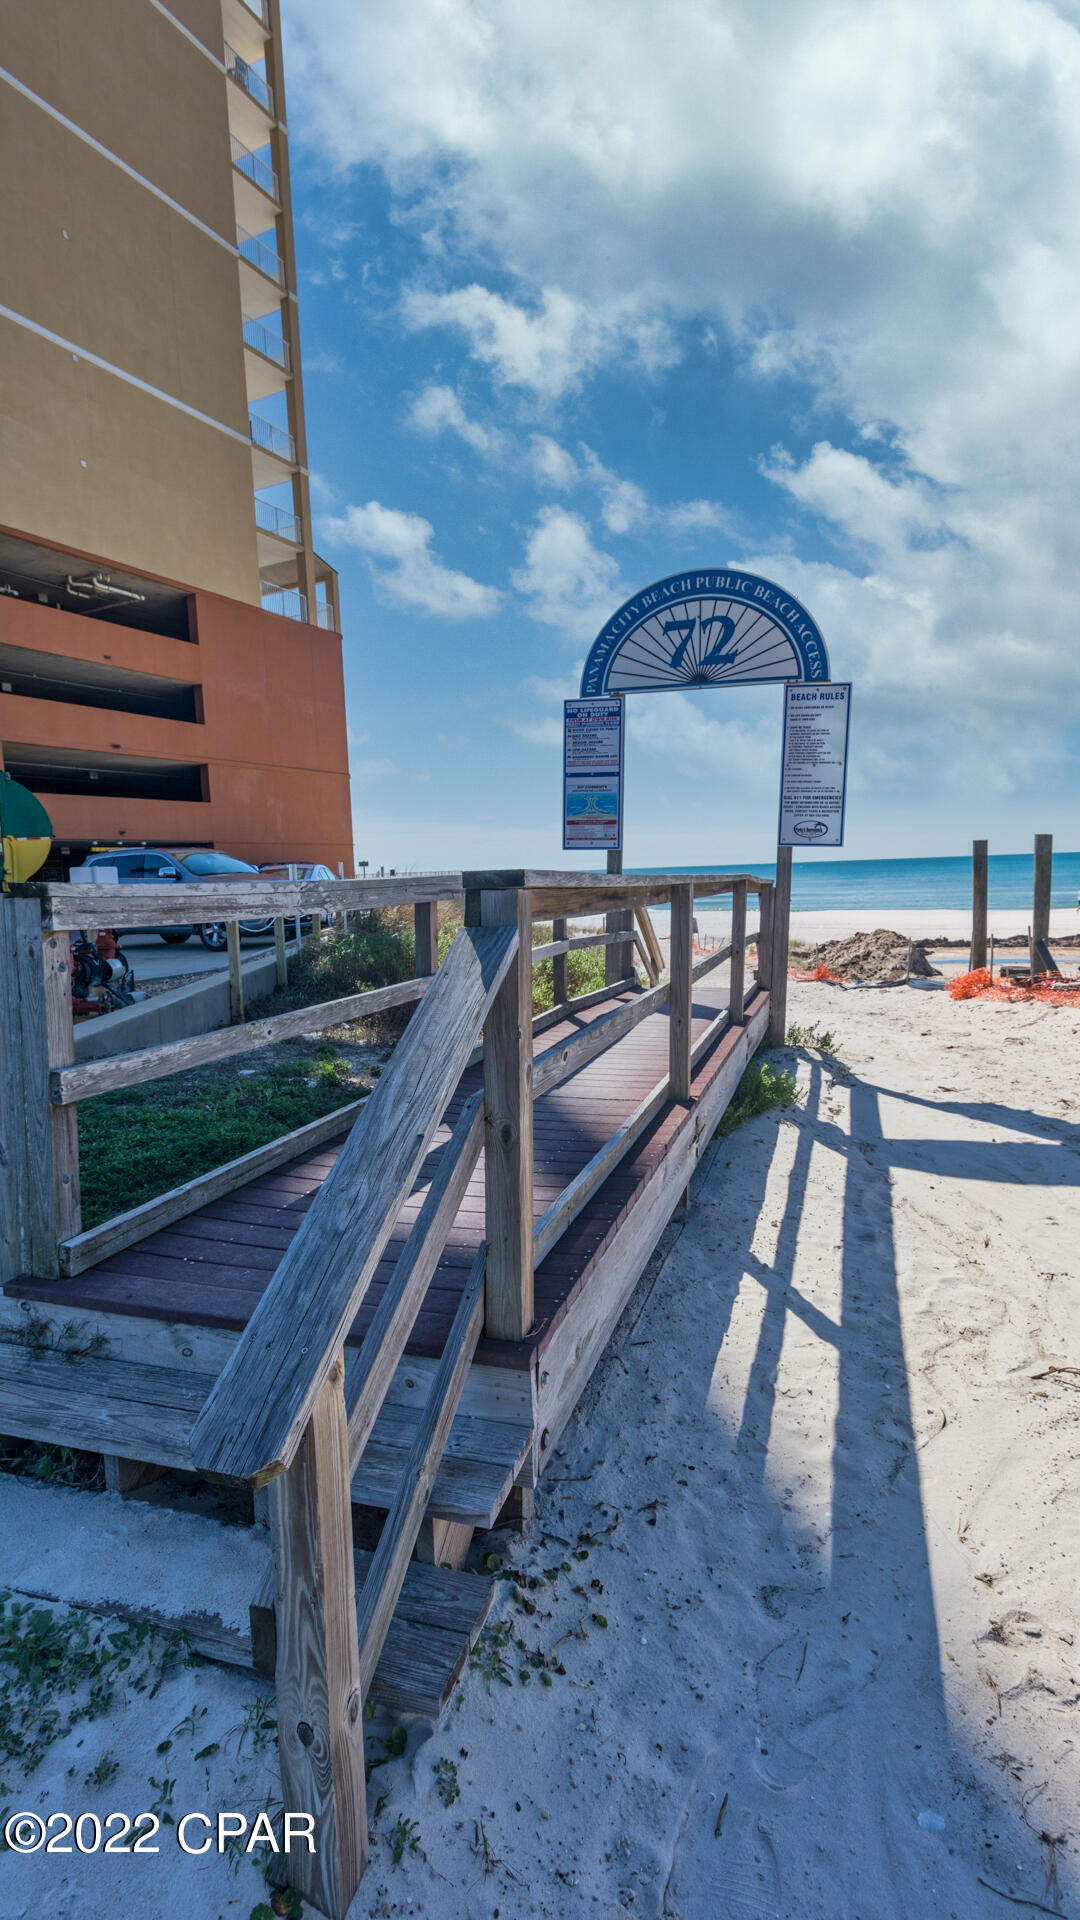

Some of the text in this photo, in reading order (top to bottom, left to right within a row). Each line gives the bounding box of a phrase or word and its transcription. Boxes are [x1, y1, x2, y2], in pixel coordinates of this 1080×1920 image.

[586, 576, 822, 693] PANAMA CITY BEACH PUBLIC BEACH ACCESS
[662, 615, 739, 669] 72
[791, 692, 845, 701] BEACH RULES
